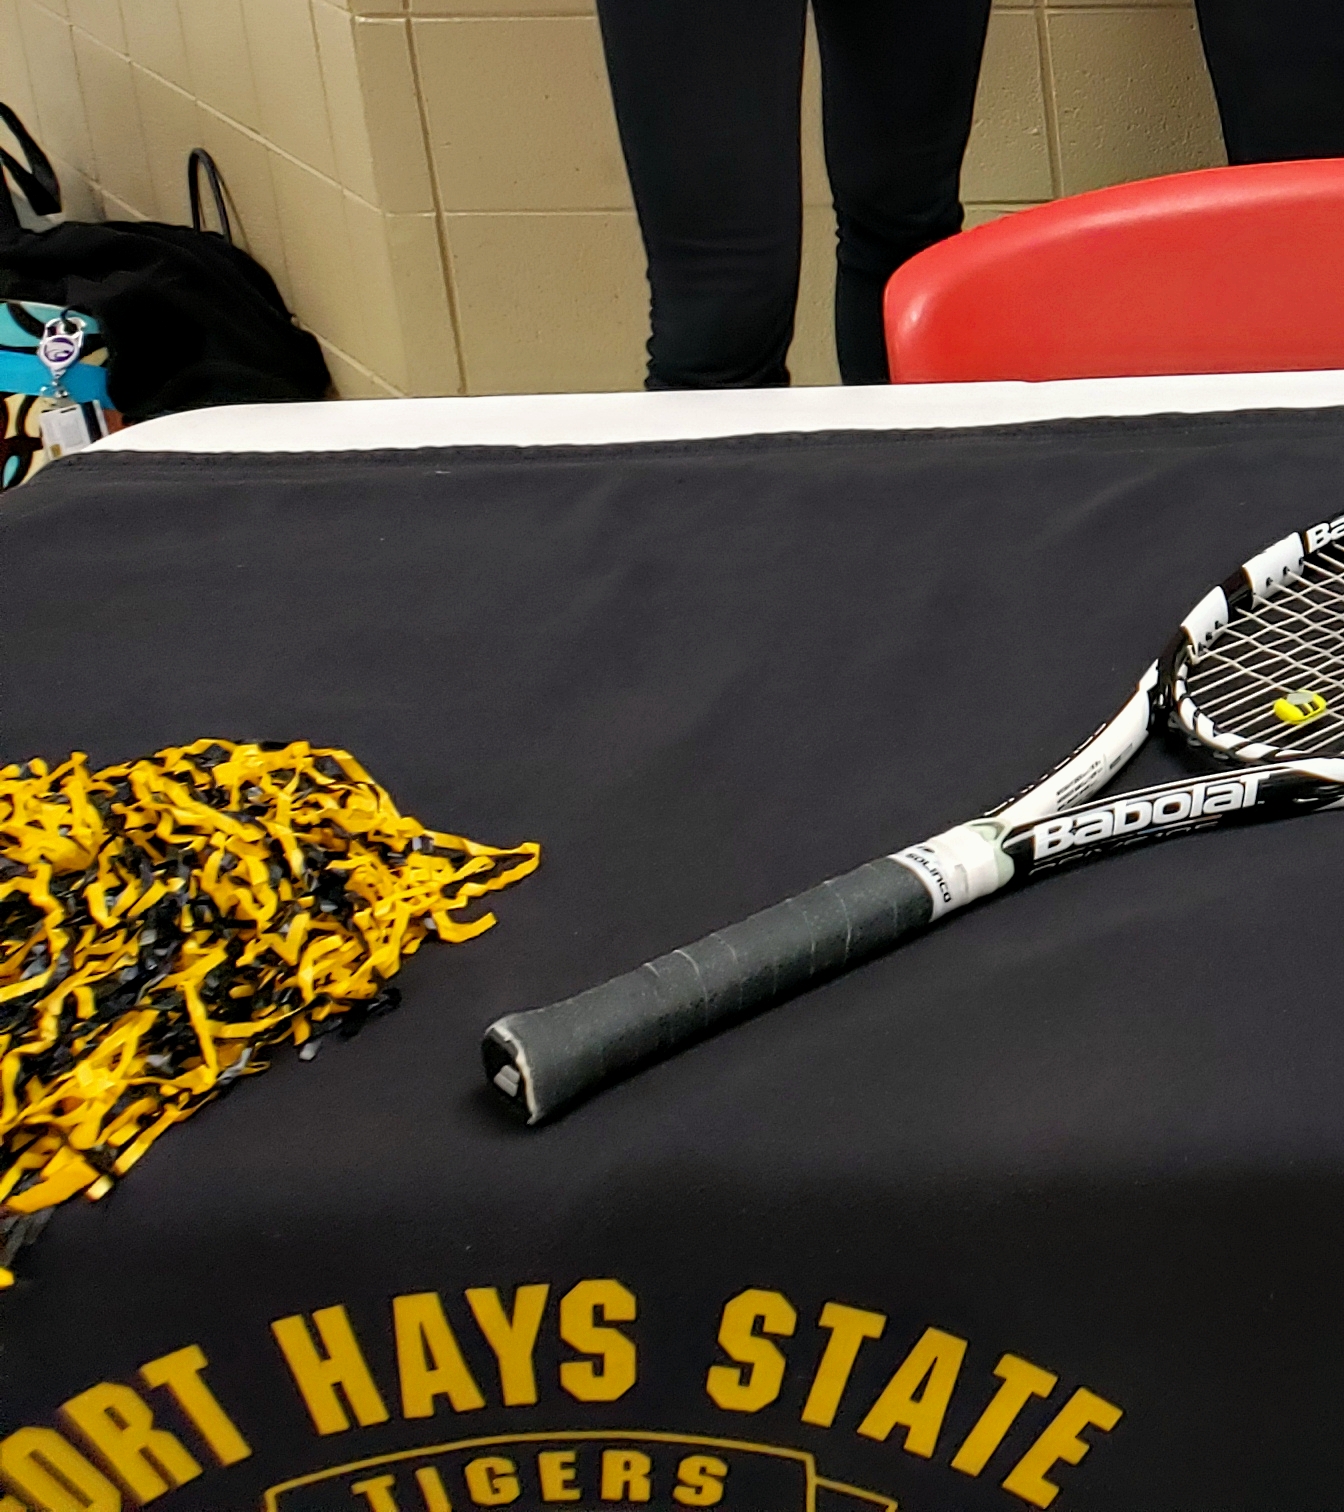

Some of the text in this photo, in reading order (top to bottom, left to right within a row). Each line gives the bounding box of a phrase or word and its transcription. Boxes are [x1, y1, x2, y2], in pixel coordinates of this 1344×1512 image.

[0, 1279, 1124, 1512] ORT HAYS STATE
[351, 1449, 729, 1512] TIGERS
